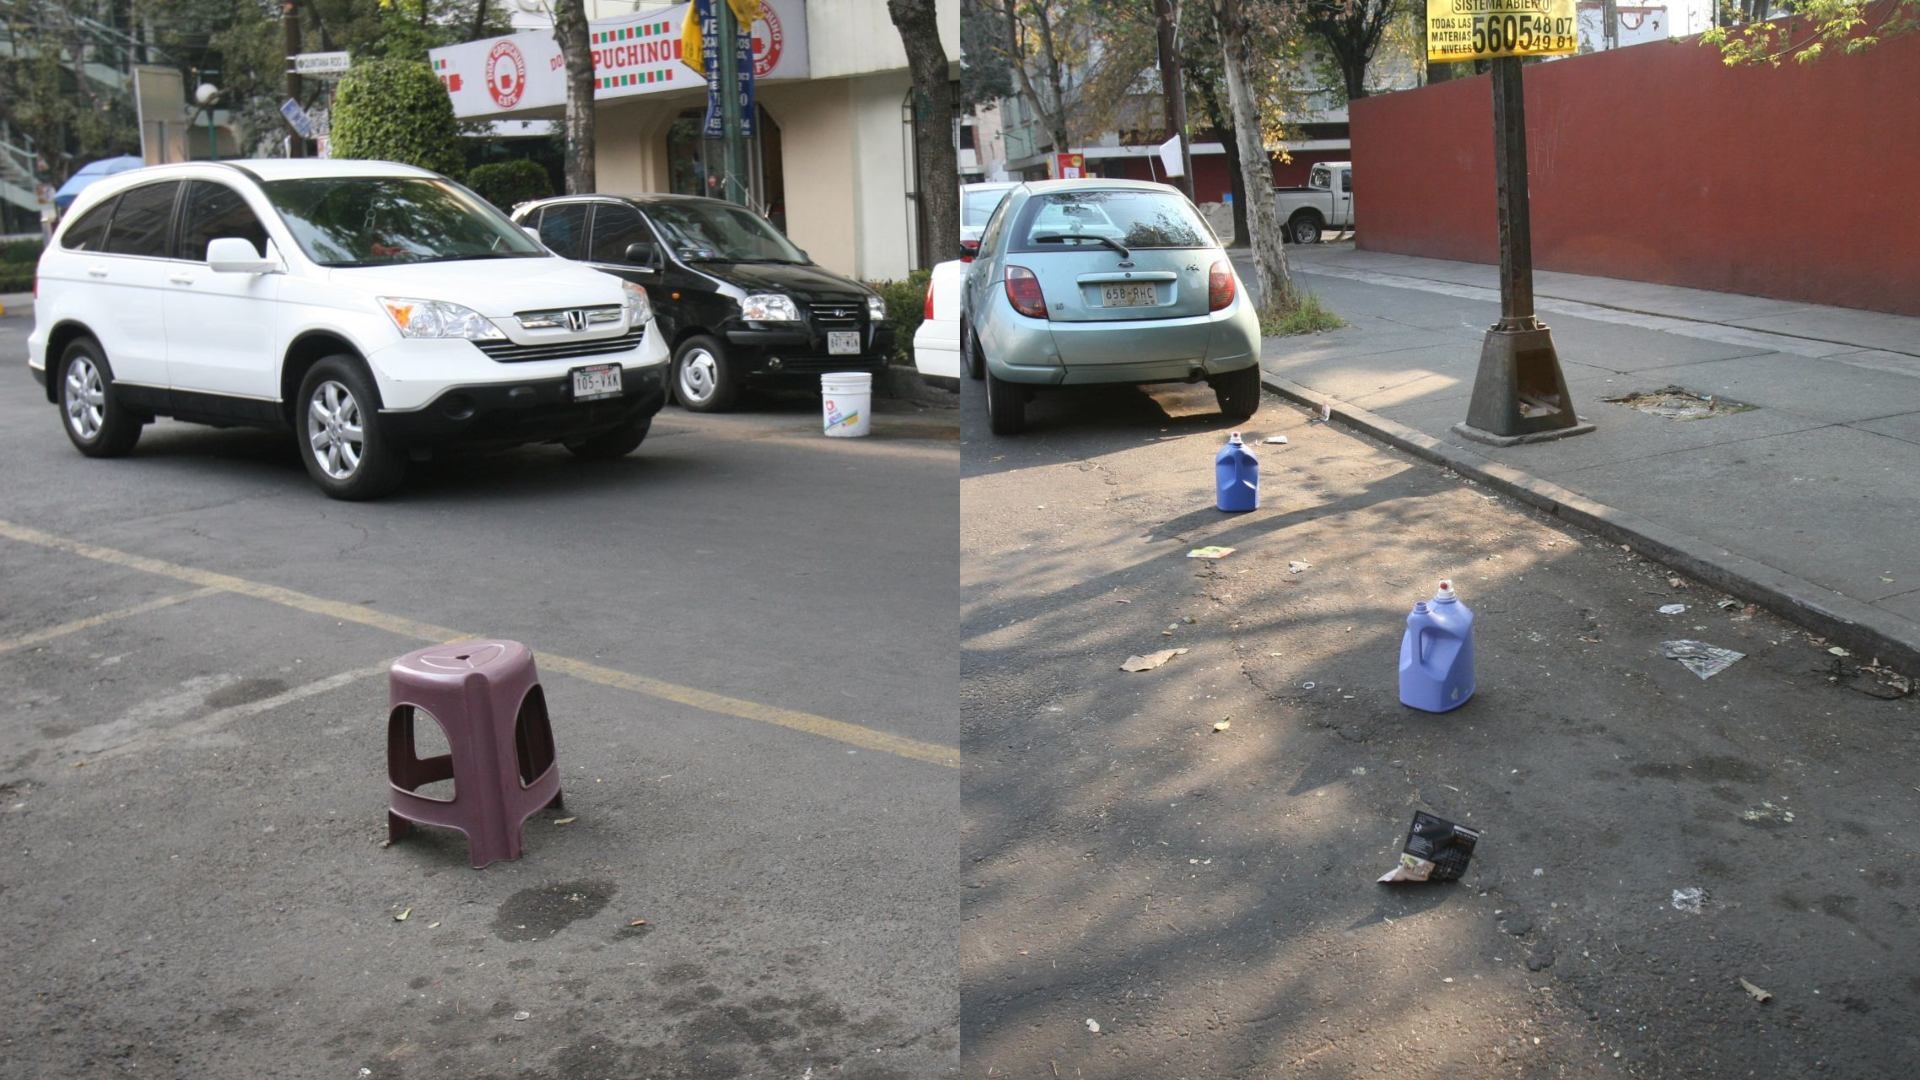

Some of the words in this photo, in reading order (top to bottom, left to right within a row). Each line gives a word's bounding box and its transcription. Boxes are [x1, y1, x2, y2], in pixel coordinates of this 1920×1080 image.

[1454, 0, 1503, 11] SISTEMA
[1431, 18, 1456, 29] TODAS
[1457, 18, 1472, 29] LAS
[1431, 31, 1472, 42] MATERIAS
[1472, 15, 1533, 53] 5605
[1533, 16, 1551, 34] 48
[1556, 17, 1573, 35] 07
[1532, 35, 1551, 50] 49
[1557, 36, 1573, 49] 81
[549, 54, 565, 72] DO
[590, 39, 671, 71] PUCHINO
[1431, 45, 1437, 55] Y
[1441, 44, 1473, 54] NIVELES
[1105, 287, 1153, 300] 658-RHC
